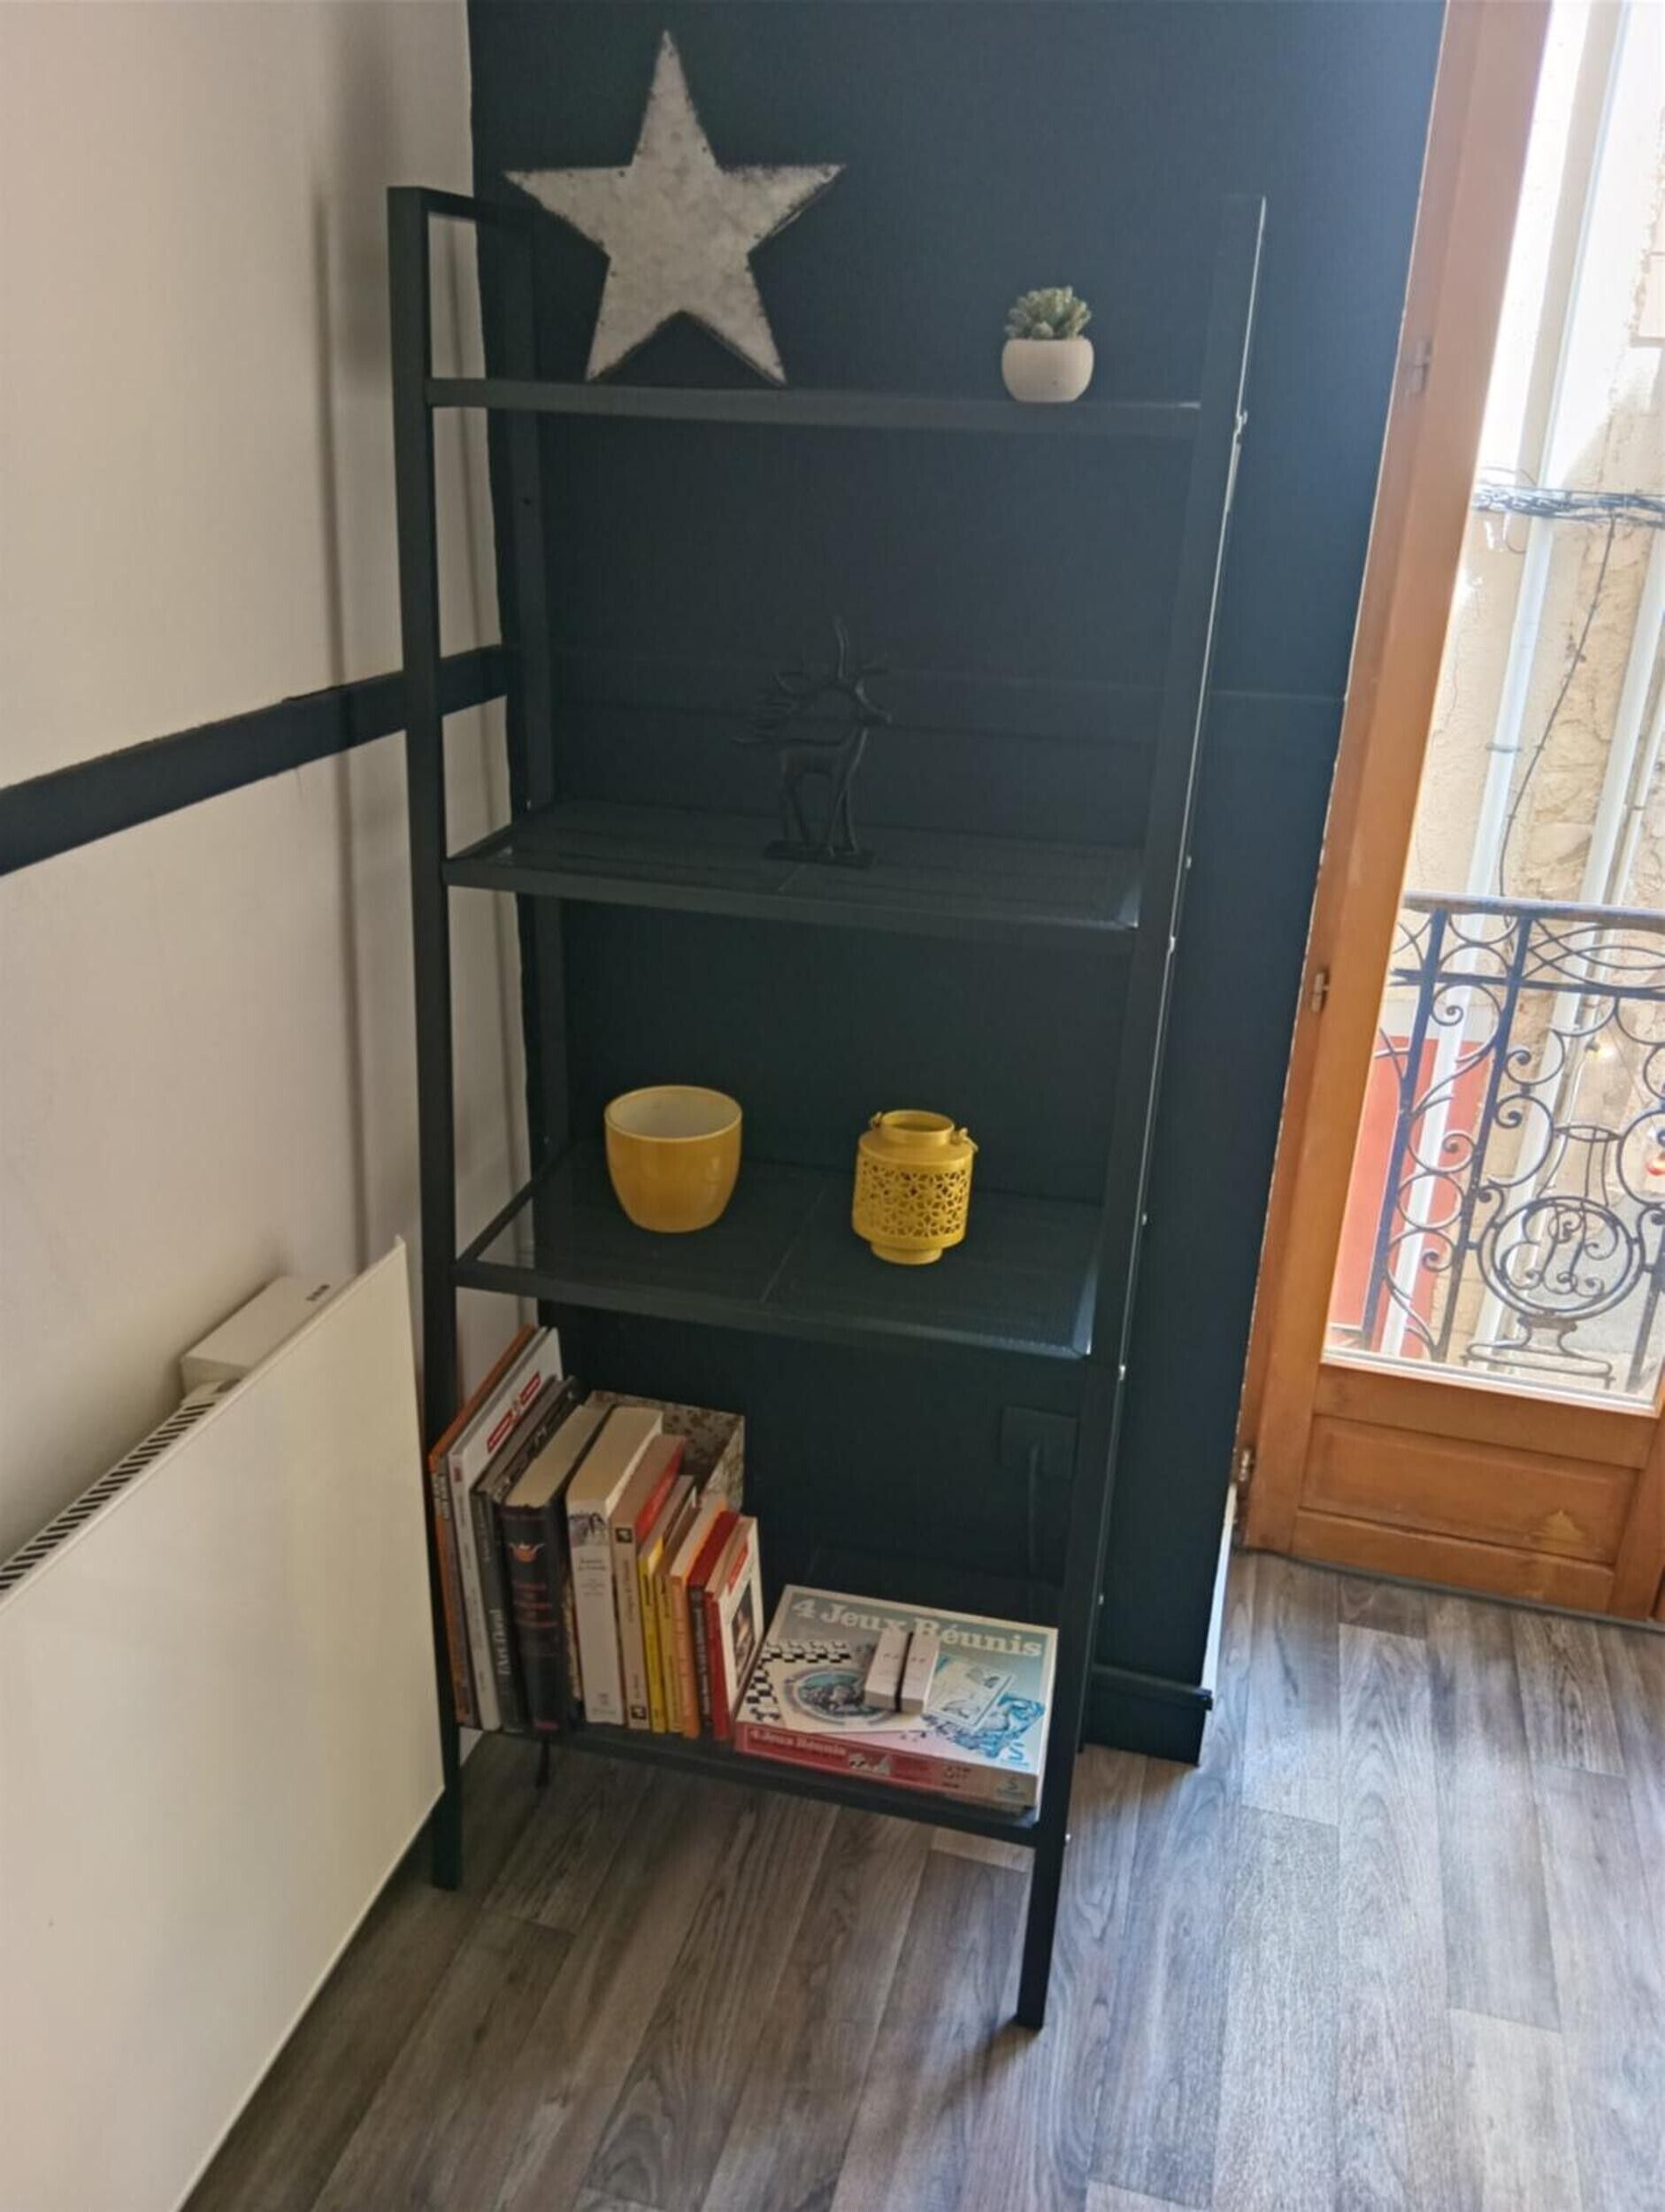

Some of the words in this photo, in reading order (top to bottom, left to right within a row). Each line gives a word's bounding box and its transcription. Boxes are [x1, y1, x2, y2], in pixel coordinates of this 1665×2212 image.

[792, 1598, 816, 1619] 4
[820, 1603, 908, 1632] Jeux
[913, 1617, 1042, 1656] Réunis
